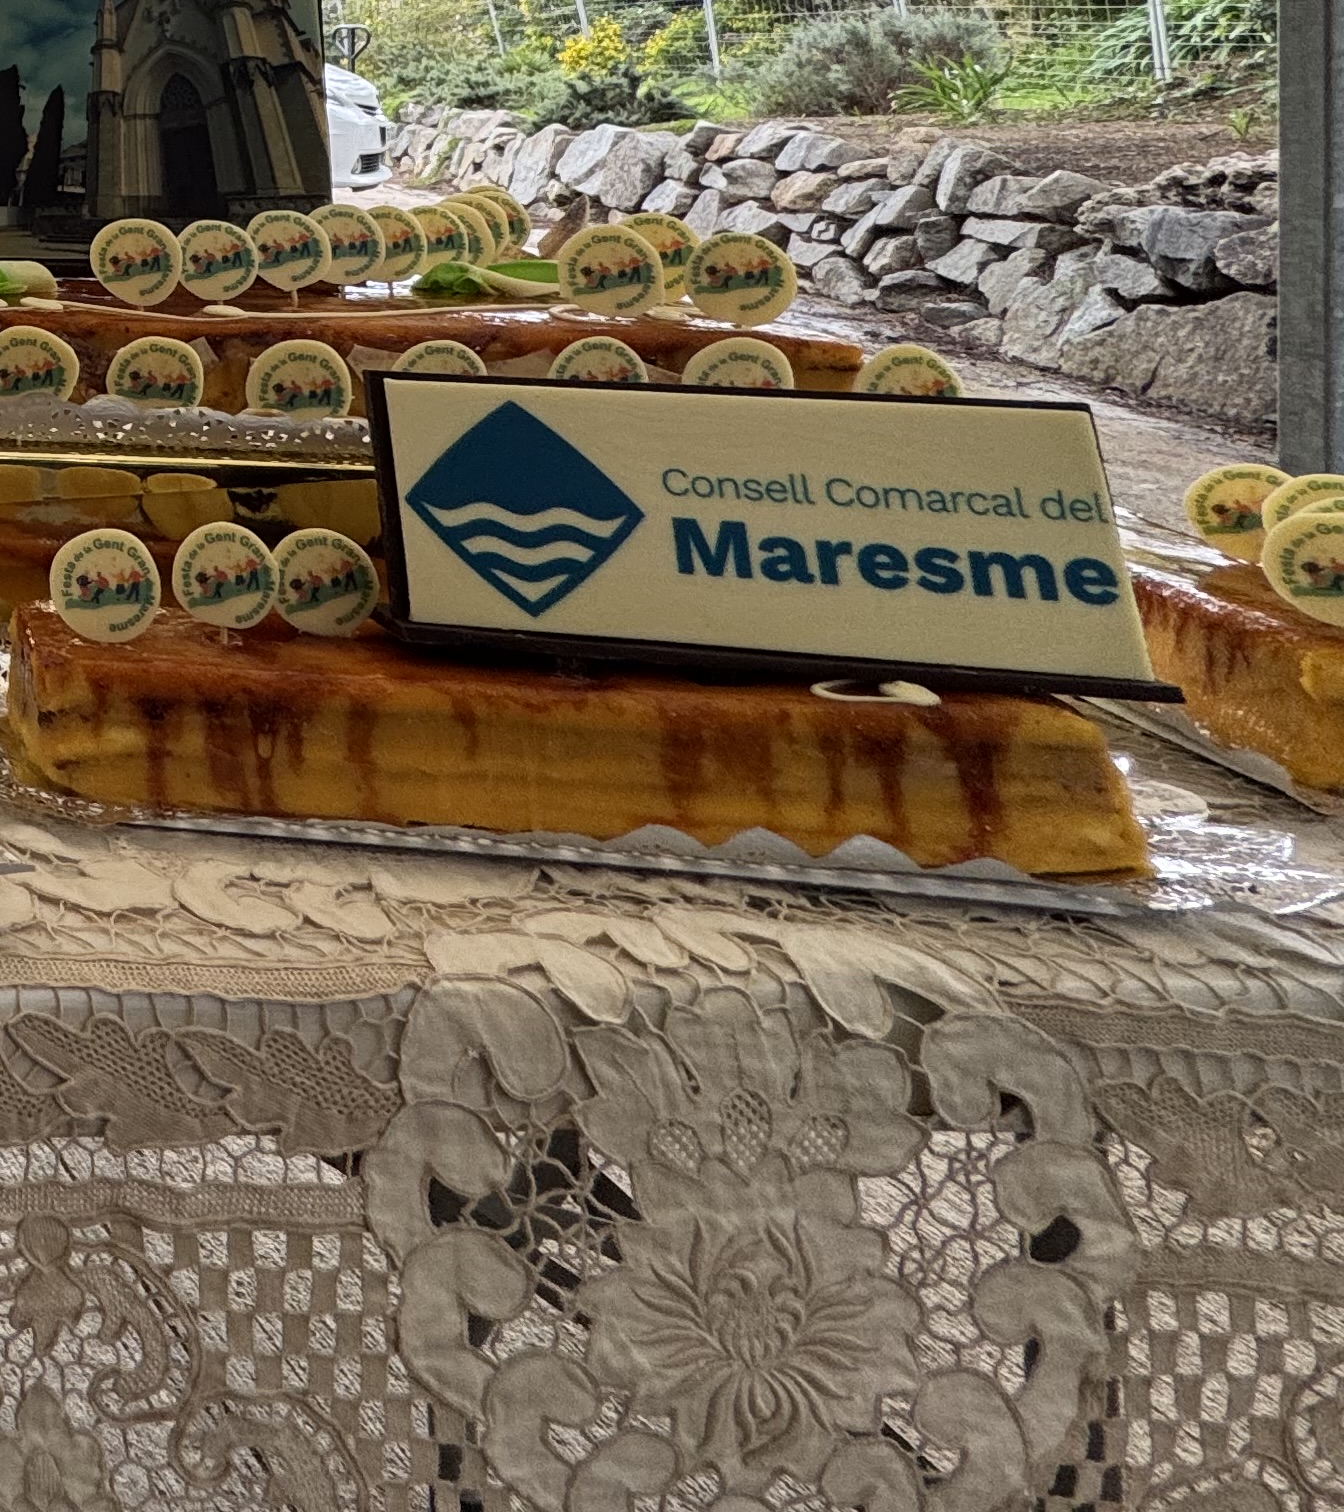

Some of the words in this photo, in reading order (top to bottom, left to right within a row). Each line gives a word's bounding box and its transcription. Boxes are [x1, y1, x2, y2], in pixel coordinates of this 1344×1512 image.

[661, 468, 814, 506] Consell
[825, 477, 1028, 520] Comarcal
[1041, 489, 1105, 524] del
[671, 516, 1120, 607] Maresme
